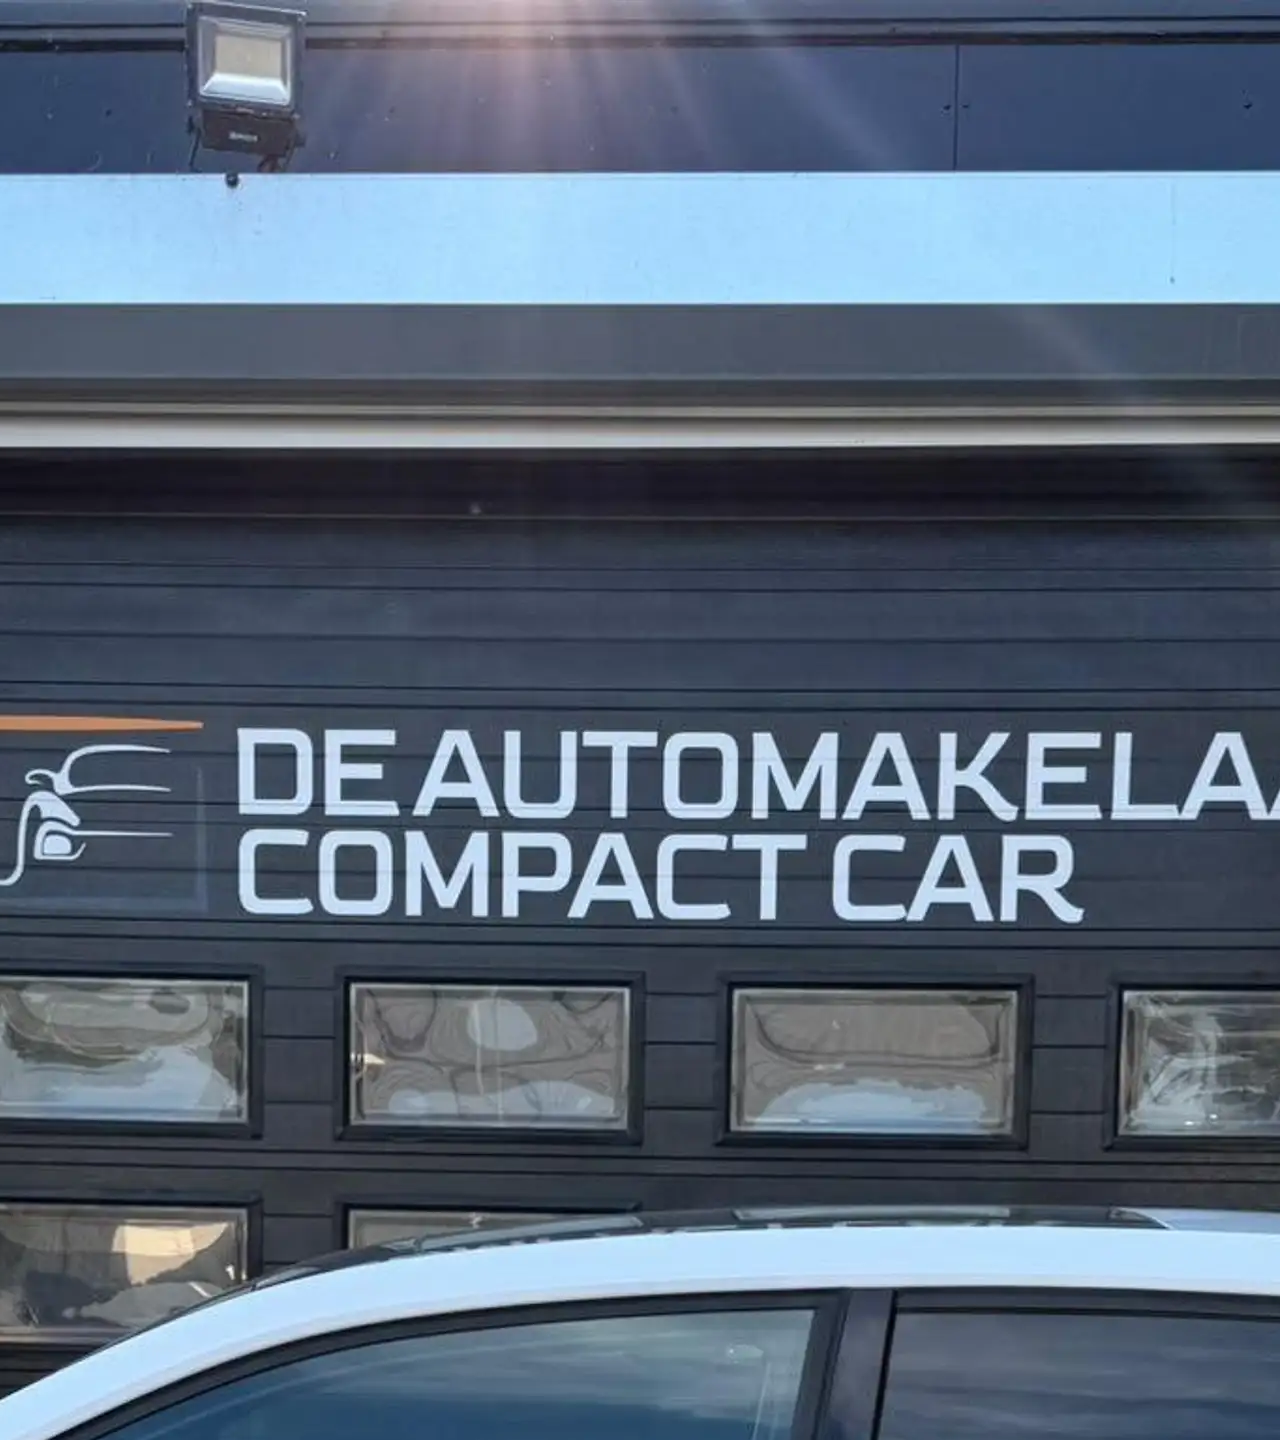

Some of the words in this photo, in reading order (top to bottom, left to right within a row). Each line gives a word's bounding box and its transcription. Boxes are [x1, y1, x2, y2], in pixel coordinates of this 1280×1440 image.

[238, 728, 399, 816] DE
[239, 829, 807, 920] COMPACT
[833, 835, 1084, 923] CAR
